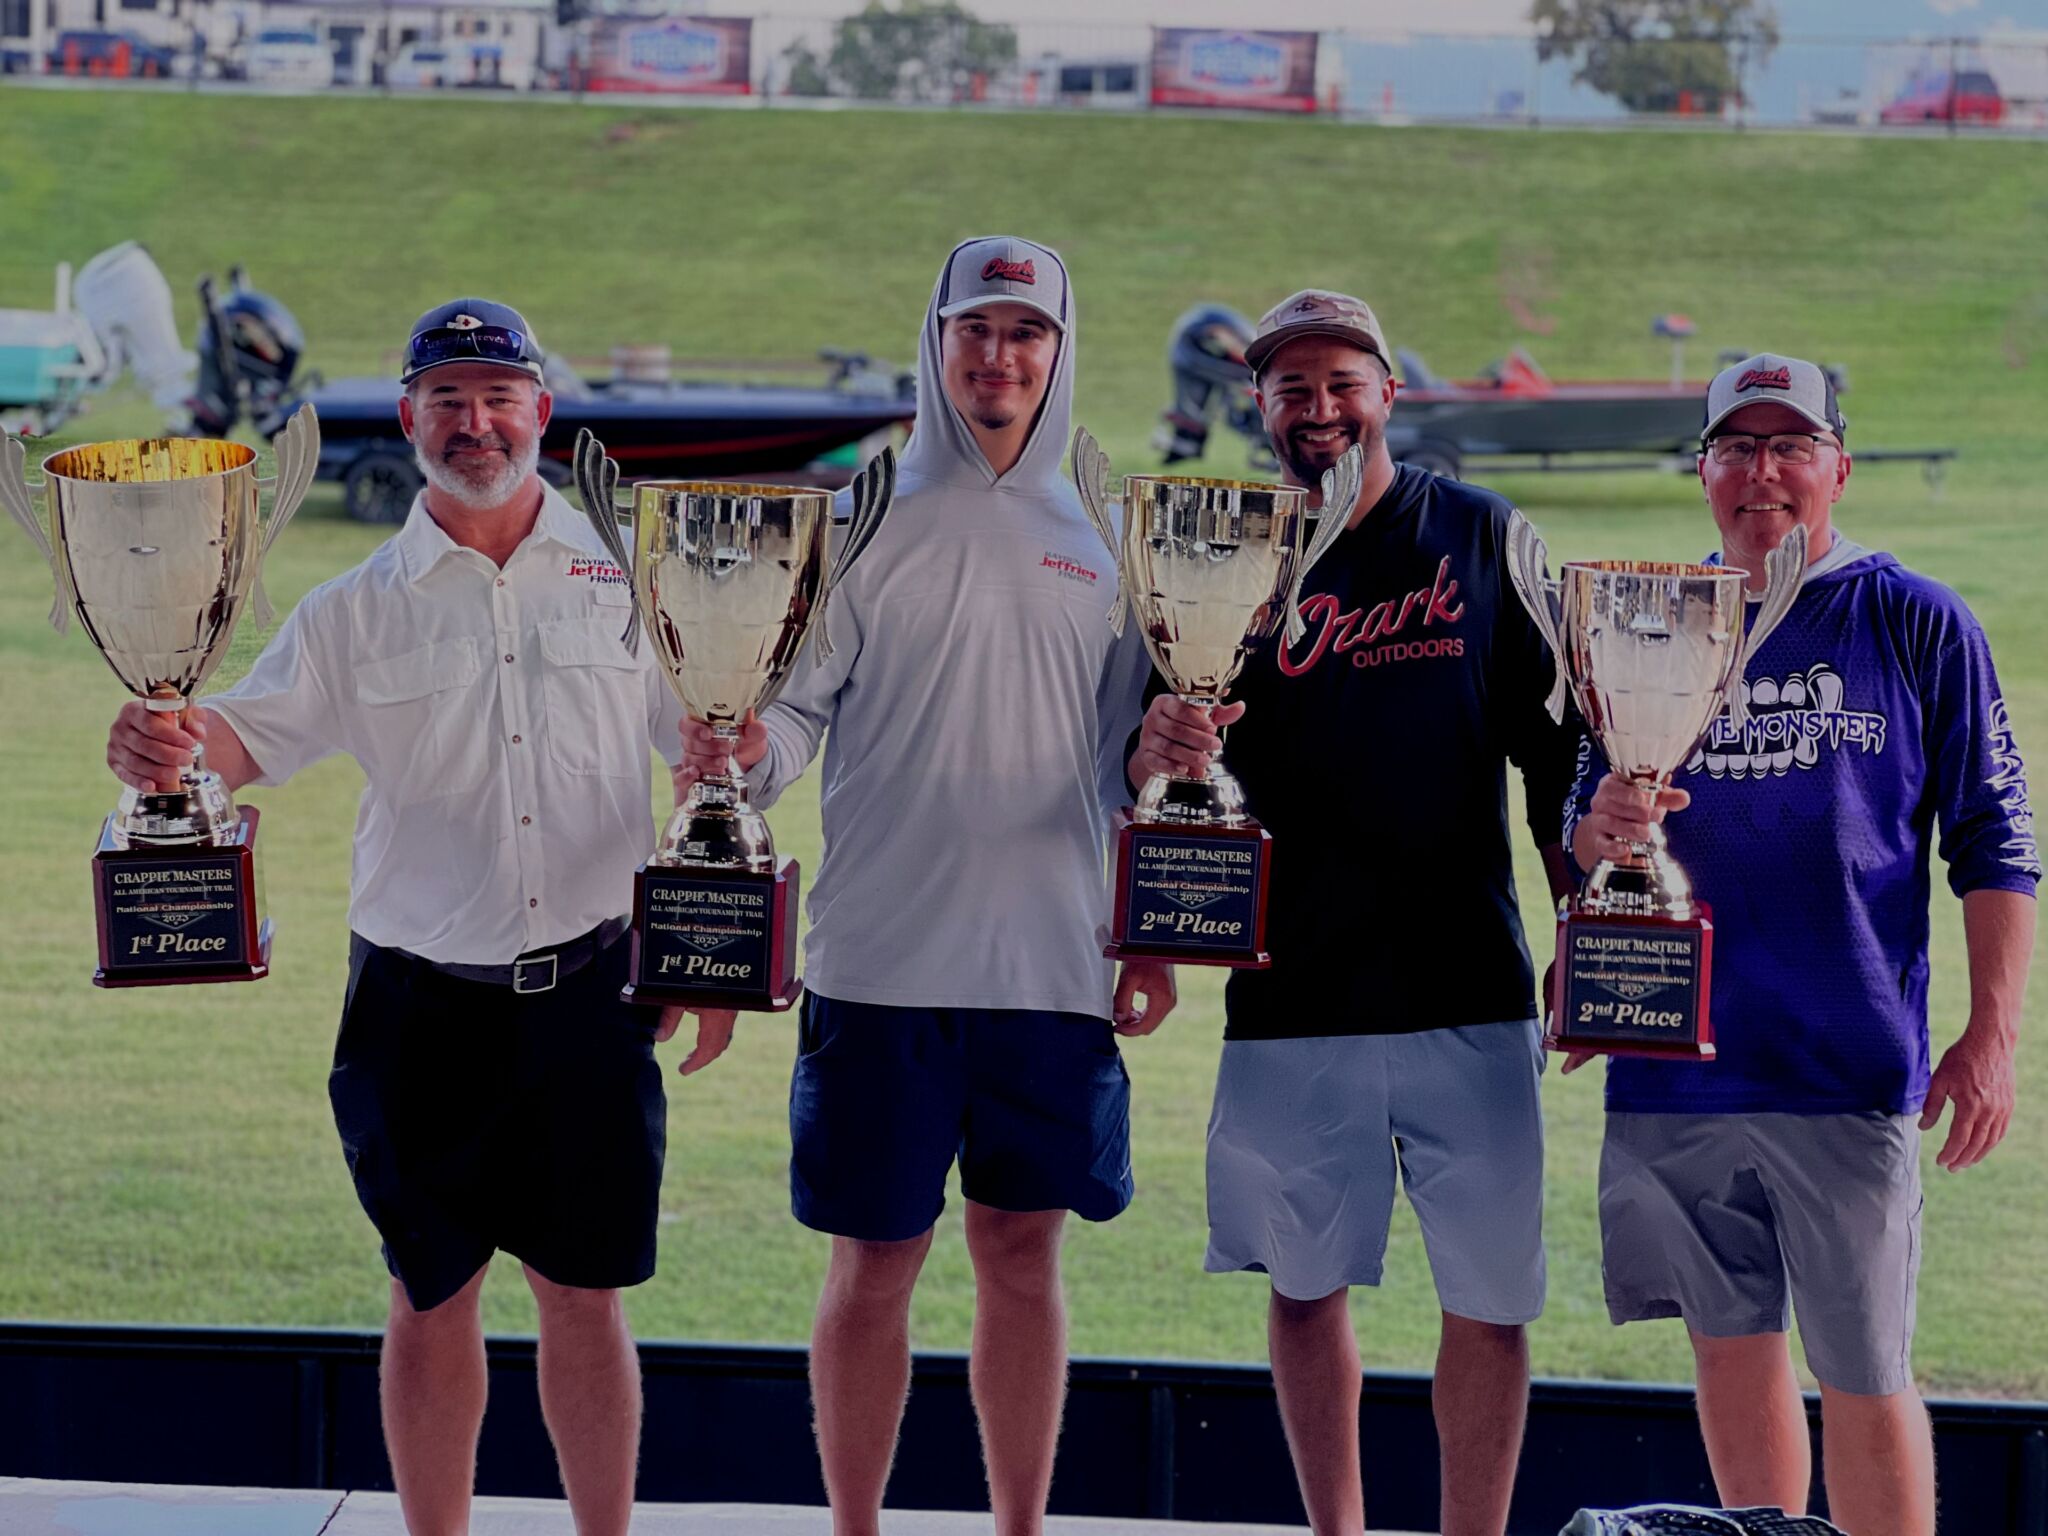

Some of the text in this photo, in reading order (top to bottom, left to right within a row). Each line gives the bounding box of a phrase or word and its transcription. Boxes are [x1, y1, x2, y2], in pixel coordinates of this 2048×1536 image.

[571, 558, 614, 566] HAYDEN
[1039, 557, 1097, 580] Jeffries
[566, 565, 624, 576] Jeffrie
[590, 575, 628, 585] FISHIN
[1278, 555, 1464, 676] Ozark
[1352, 638, 1464, 668] OUTDOORS
[1140, 846, 1252, 863] CRAPPIE MASTERS
[1151, 863, 1186, 871] AMERICAN
[1187, 865, 1232, 874] TOURNAMENT
[114, 869, 232, 884] CRAPPIE MASTERS
[128, 887, 164, 895] AMERICAN
[163, 886, 213, 894] TOURNAMENT
[1137, 880, 1250, 894] National Championship
[652, 888, 764, 906] CRAPPIE MASTERS
[116, 901, 234, 913] National Championship
[664, 906, 698, 914] AMERICAN
[697, 908, 744, 917] TOURNAMENT
[650, 922, 763, 937] National Championship
[1139, 911, 1242, 935] 2nd Place
[129, 933, 226, 955] 1st Place
[1576, 936, 1691, 954] CRAPPIE MASTERS
[658, 954, 752, 978] 1st Place
[1588, 954, 1623, 962] AMERICAN
[1624, 955, 1670, 965] TOURNAMENT
[1671, 958, 1692, 966] TRAIL
[1574, 971, 1690, 986] National Championship
[1578, 1002, 1683, 1028] 2nd Place
